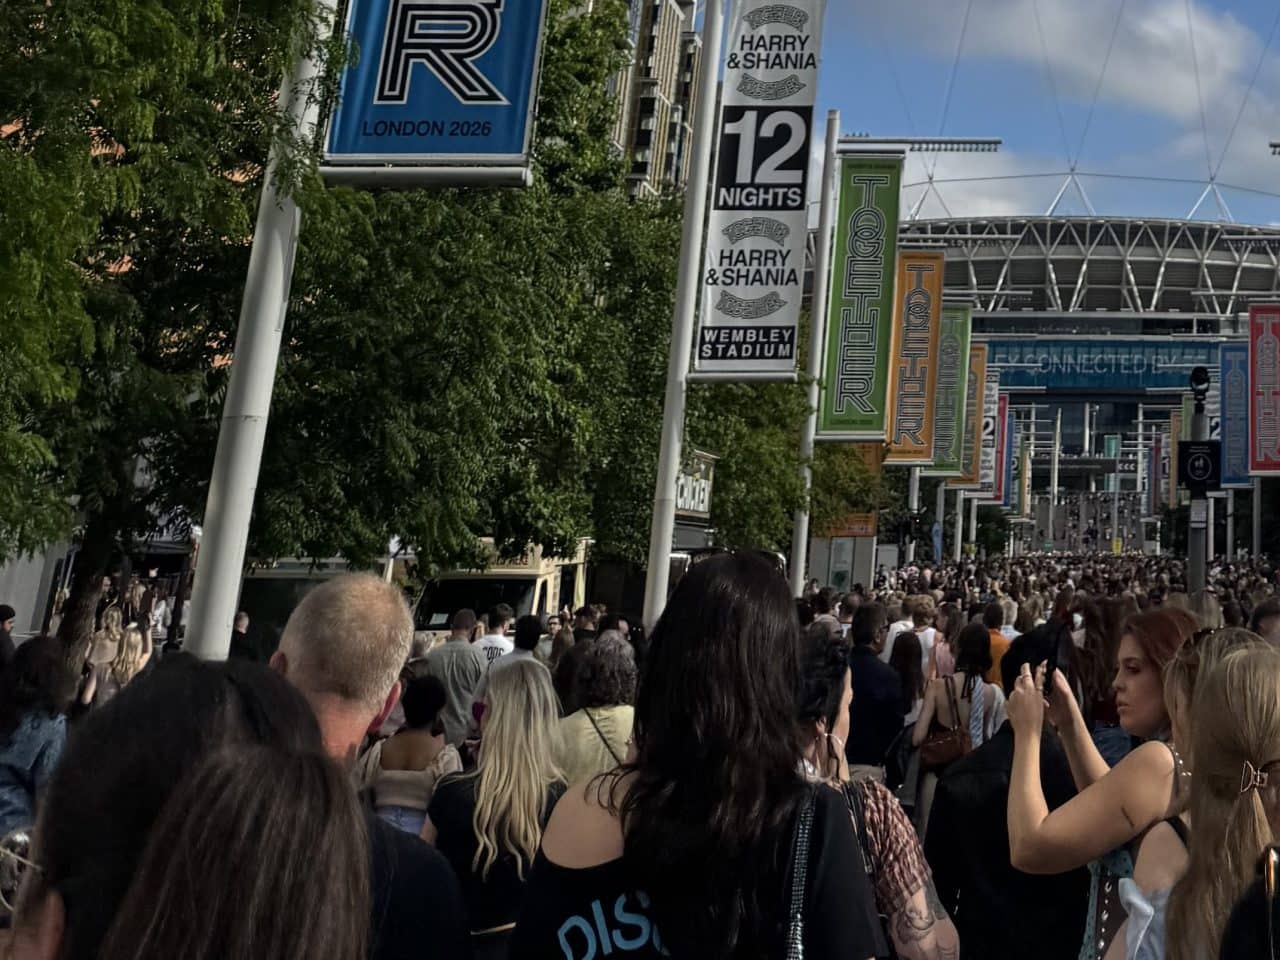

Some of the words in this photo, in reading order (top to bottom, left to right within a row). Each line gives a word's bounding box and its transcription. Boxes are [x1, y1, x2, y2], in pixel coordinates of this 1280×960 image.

[740, 34, 810, 51] HARRY
[363, 120, 449, 138] LONDON
[450, 120, 492, 137] 2026
[723, 110, 806, 184] 12
[718, 187, 802, 207] NIGHTS
[719, 249, 791, 267] HARRY
[833, 175, 890, 415] TOGETHER
[703, 329, 792, 342] WEMBLEY
[701, 344, 791, 357] STADIUM
[893, 264, 936, 446] TOGETHER
[1025, 354, 1146, 374] CONNECTED
